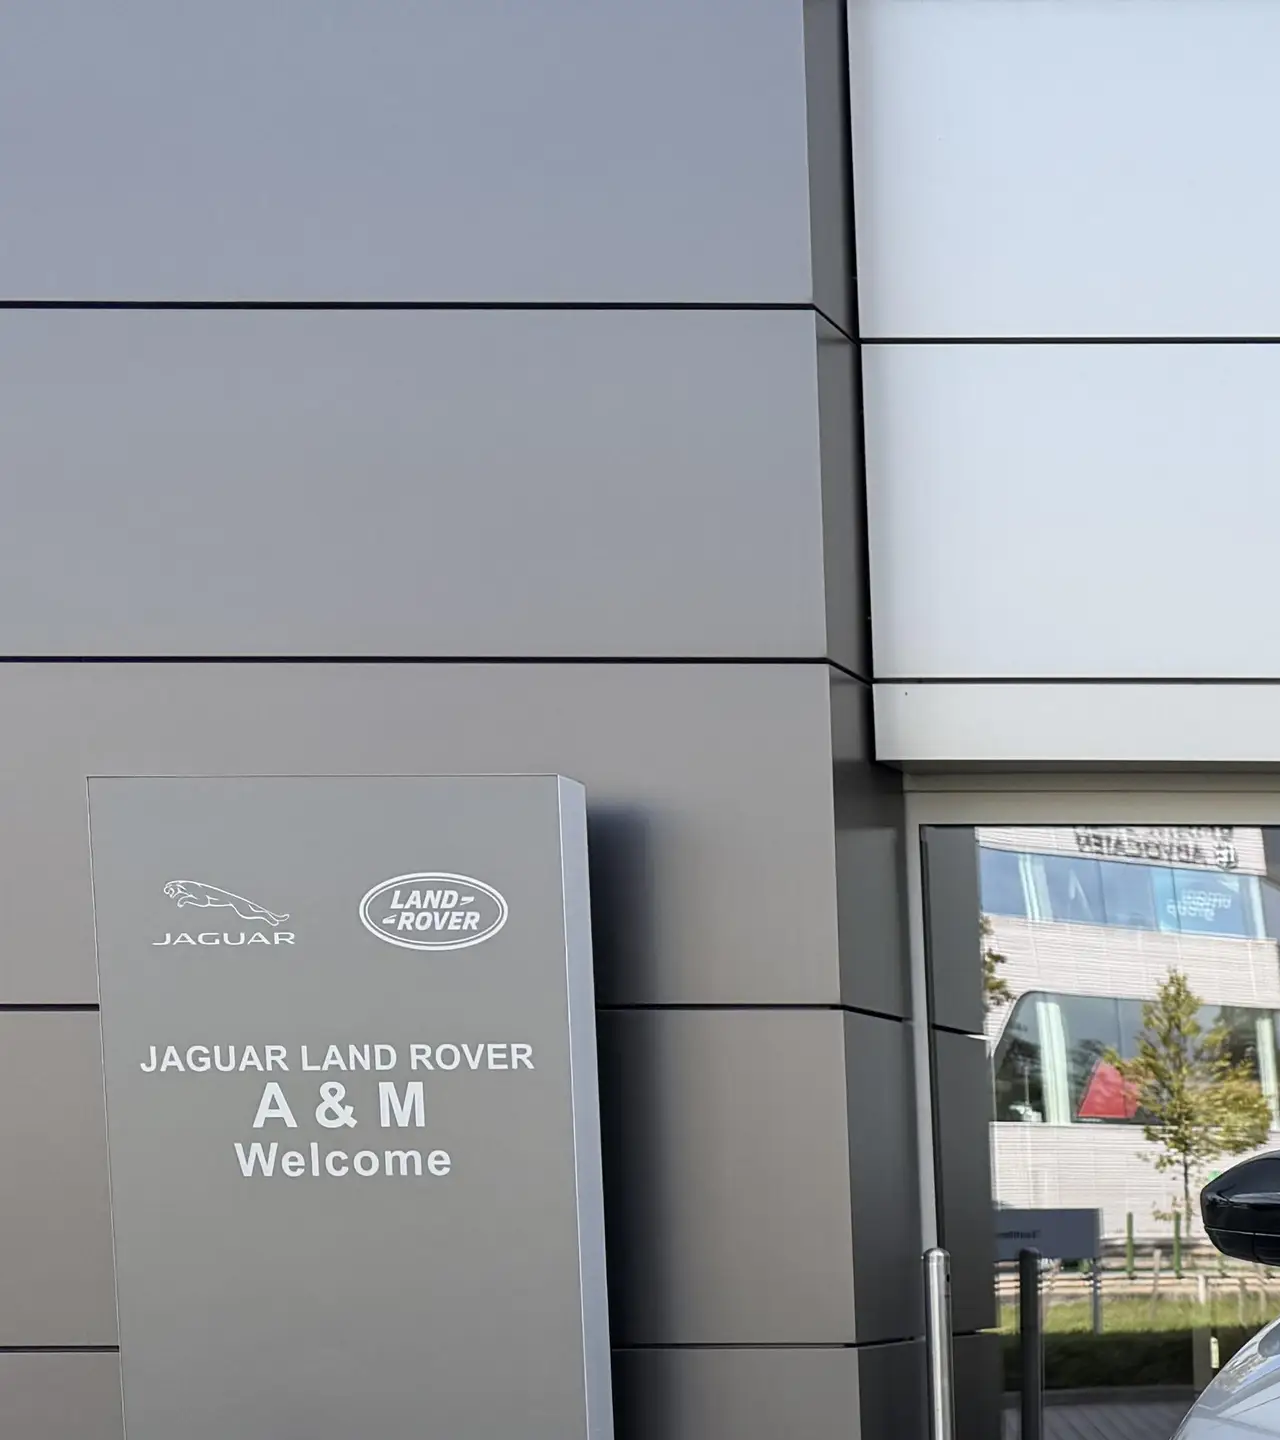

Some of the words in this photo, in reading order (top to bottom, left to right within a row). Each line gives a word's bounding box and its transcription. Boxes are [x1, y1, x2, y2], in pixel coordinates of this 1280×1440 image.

[390, 890, 463, 909] LAND
[397, 911, 480, 930] ROVER
[152, 932, 295, 946] JAGUAR
[140, 1045, 289, 1072] JAGUAR
[301, 1044, 397, 1071] LAND
[410, 1043, 535, 1070] ROVER
[234, 1142, 452, 1177] Welcome
